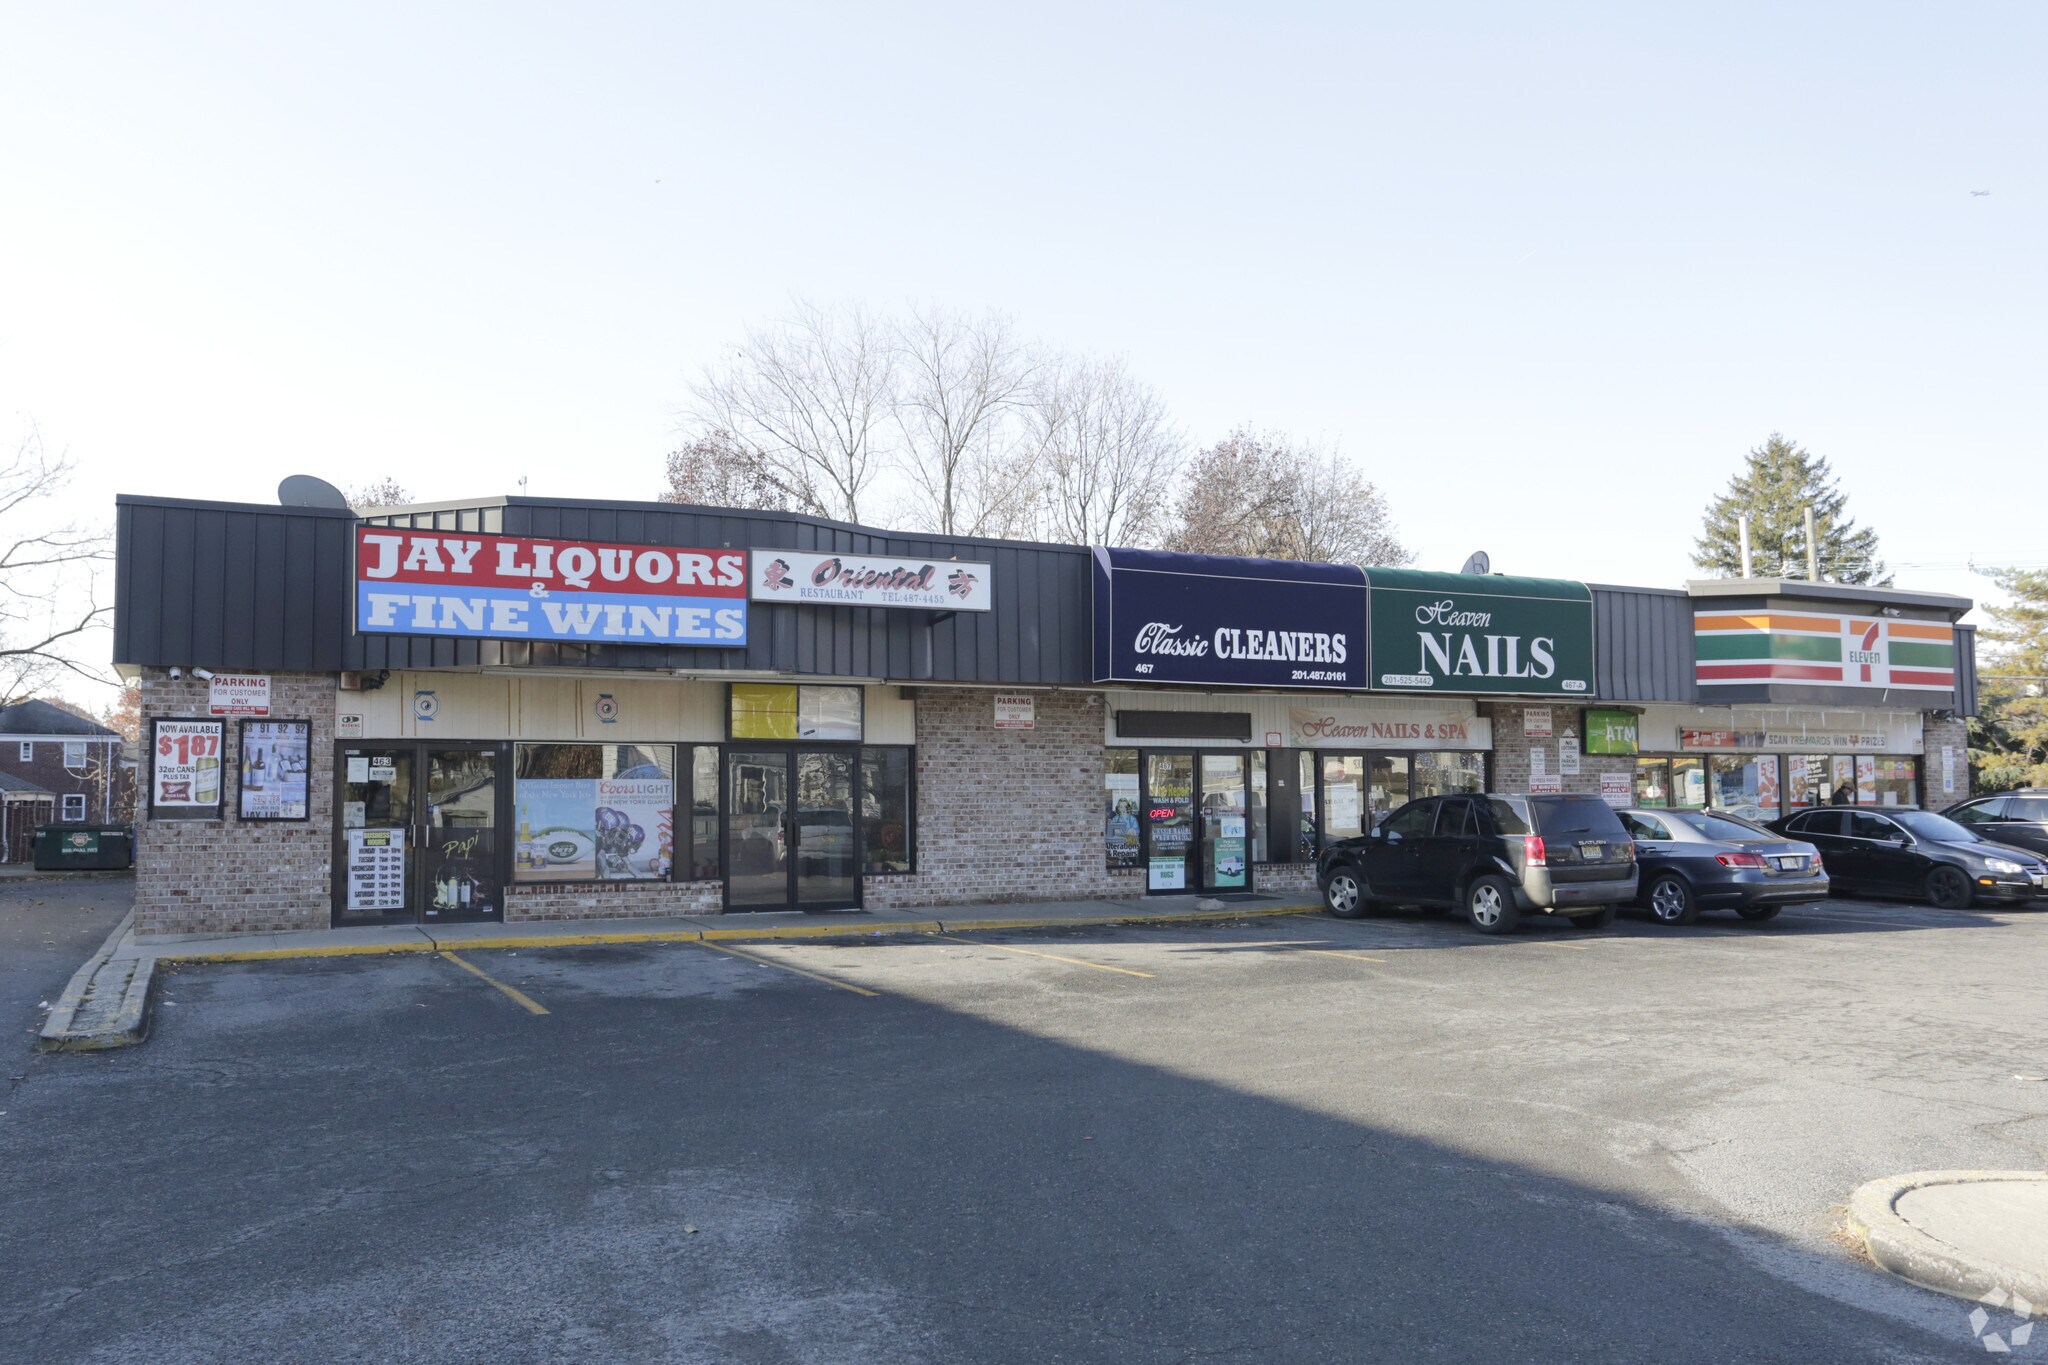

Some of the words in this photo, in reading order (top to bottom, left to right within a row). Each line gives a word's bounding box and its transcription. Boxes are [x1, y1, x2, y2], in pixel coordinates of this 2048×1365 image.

[363, 534, 482, 579] JAY
[496, 542, 744, 589] LIQUORS
[811, 557, 936, 592] Oriental
[529, 582, 550, 598] &
[800, 587, 865, 600] RESTAURANT
[882, 591, 945, 605] TEL:487-4455
[367, 593, 529, 632] FINE
[541, 602, 744, 639] WINES
[1415, 600, 1491, 627] Heaven
[1134, 622, 1208, 657] Classic
[1214, 627, 1347, 664] CLEANERS
[1417, 631, 1555, 679] NAILS
[1135, 664, 1154, 674] 467
[1291, 670, 1347, 681] 201.487.0161
[215, 677, 266, 687] PARKING
[1384, 676, 1432, 686] 201-525-5442
[1564, 681, 1584, 689] 467-A
[229, 689, 267, 697] CUSTOMER
[997, 697, 1031, 705] PARKING
[160, 725, 177, 733] NOW
[178, 725, 219, 734] AVAILABLE
[260, 724, 270, 733] 91
[277, 724, 288, 733] 92
[295, 725, 306, 734] 92
[1302, 716, 1368, 738] Heaven
[1371, 722, 1420, 739] NAILS
[1424, 724, 1435, 739] &
[1438, 723, 1468, 739] SPA
[1605, 726, 1636, 742] ATM
[1692, 732, 1699, 744] 2
[1769, 735, 1788, 744] SCAN
[1833, 736, 1847, 746] WIN
[1861, 736, 1885, 746] PRIZES
[373, 757, 391, 765] 463
[550, 782, 574, 790] Import
[600, 782, 635, 794] Coors
[637, 785, 670, 794] LIGHT
[542, 791, 557, 799] New
[560, 791, 576, 799] York
[1149, 808, 1175, 818] OPEN
[441, 829, 479, 860] Papi
[1105, 842, 1140, 850] Alterations
[1113, 850, 1138, 858] Repairs
